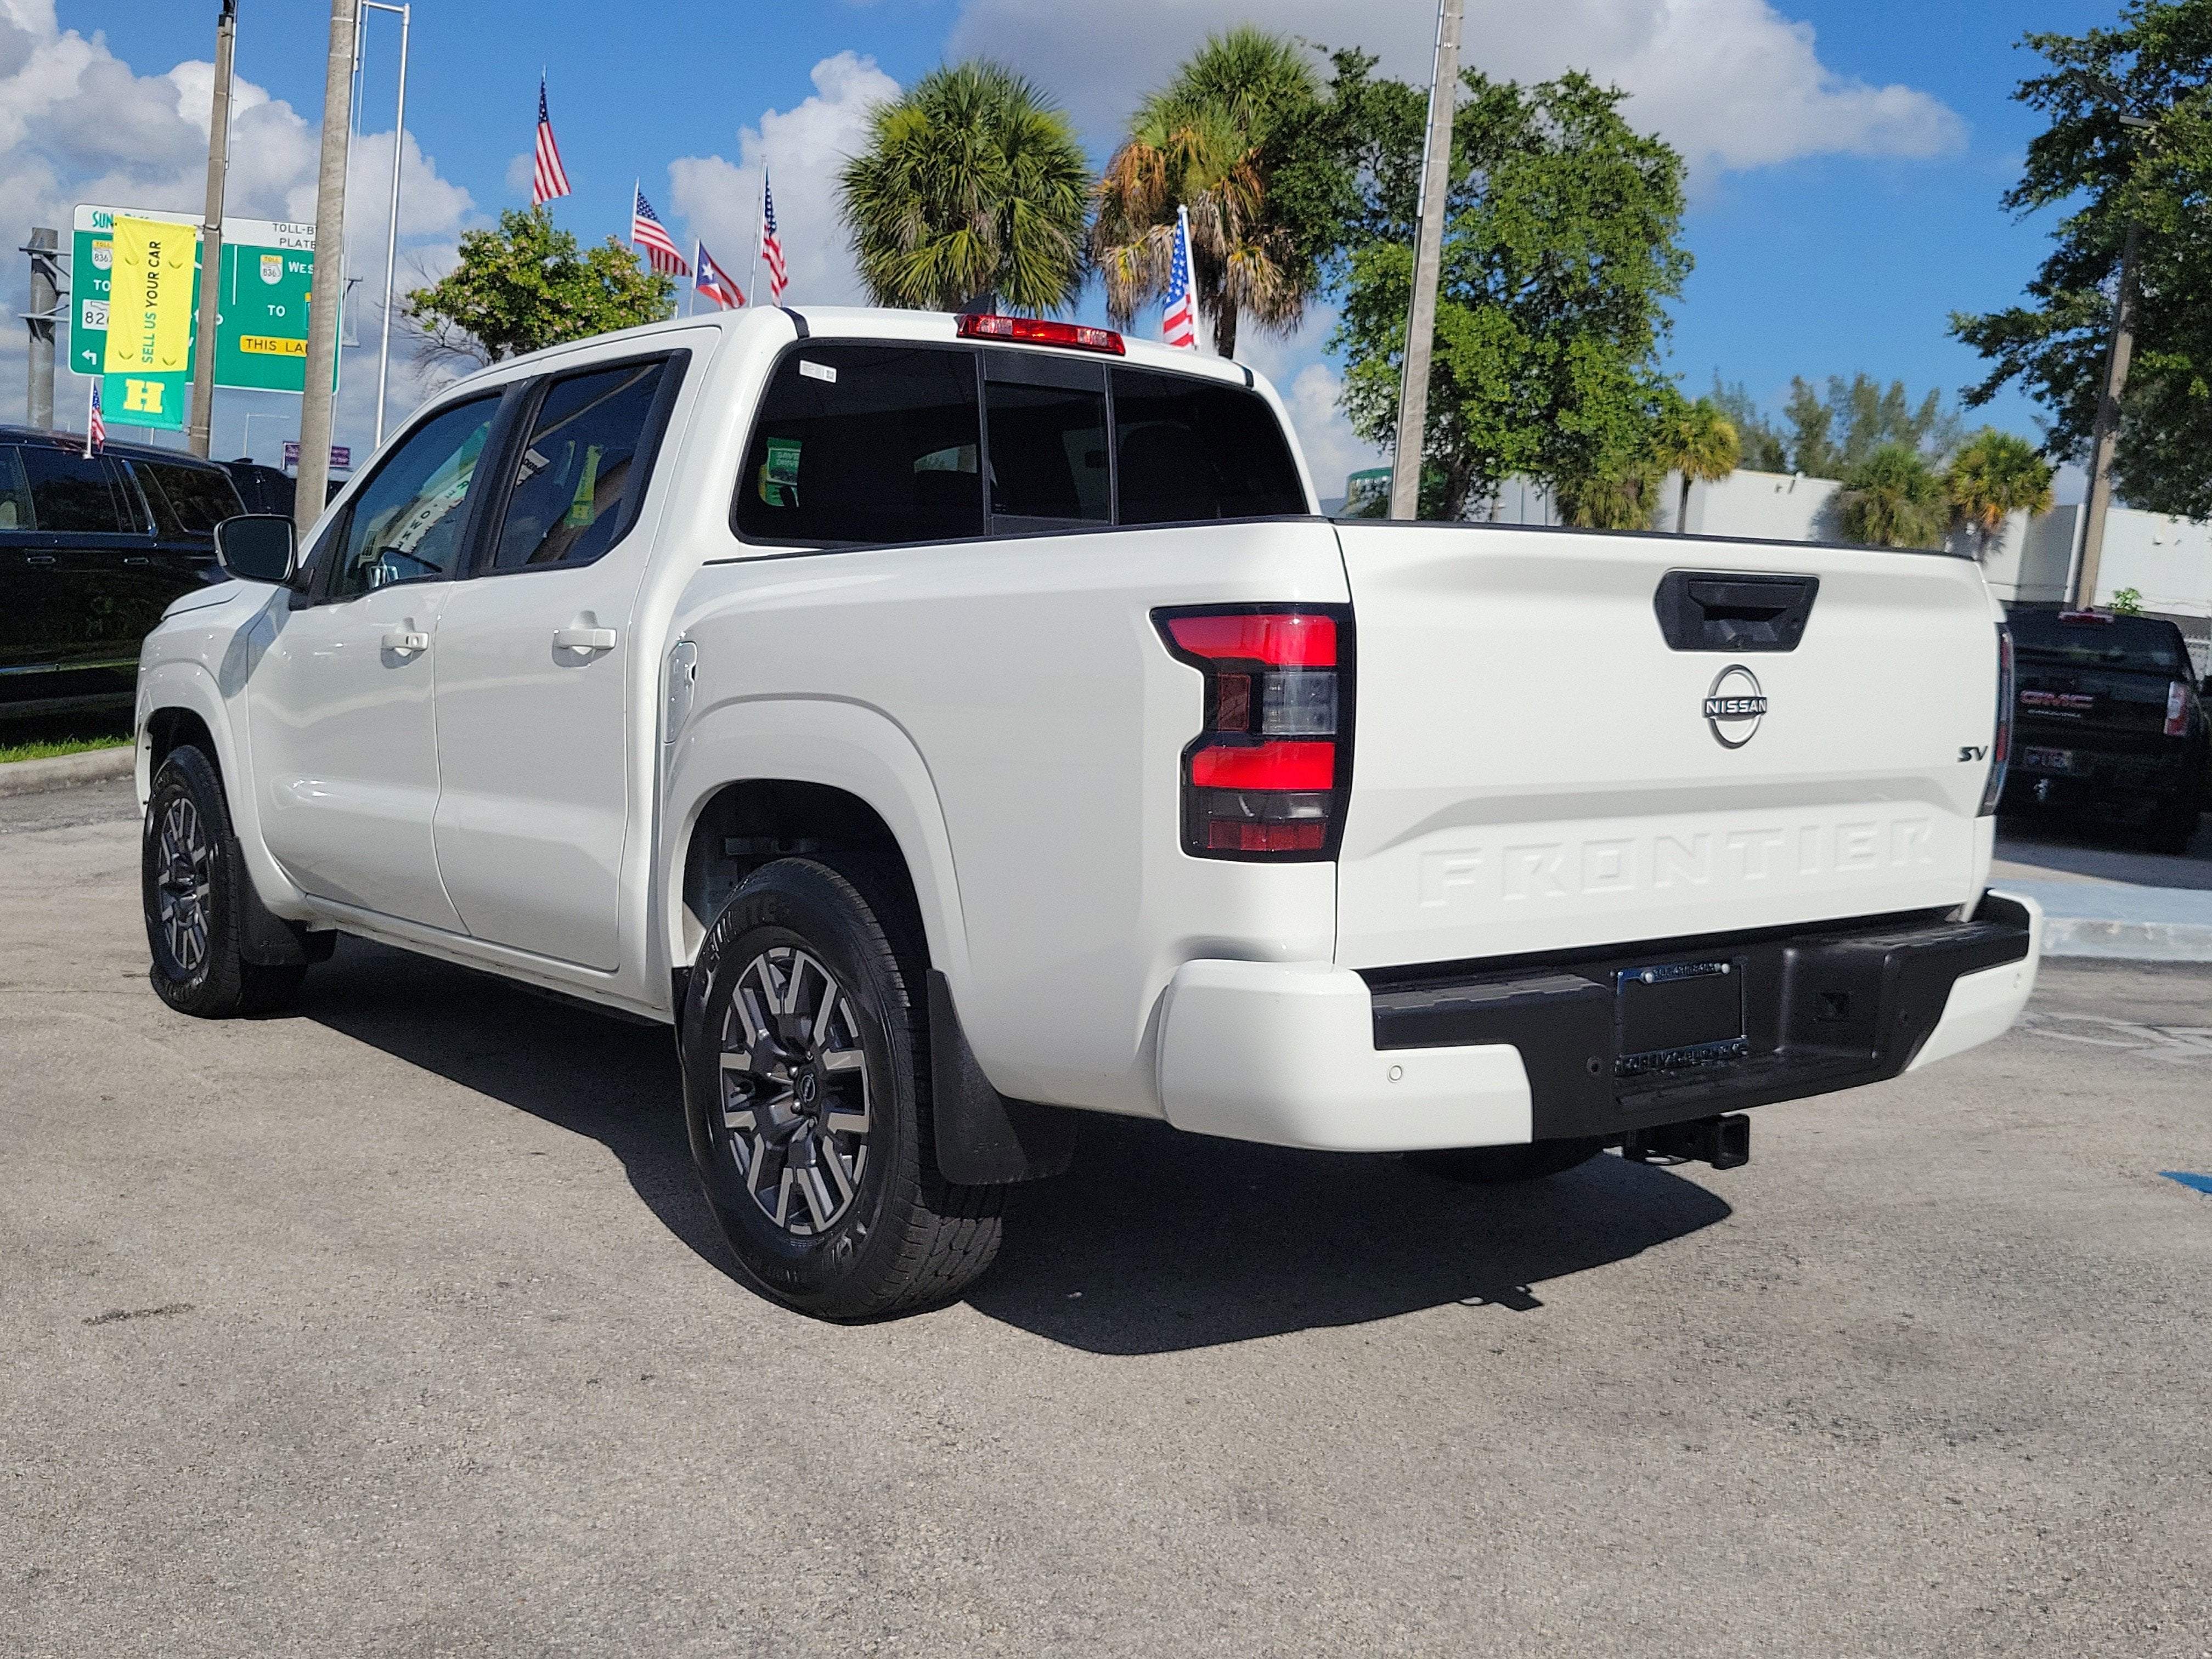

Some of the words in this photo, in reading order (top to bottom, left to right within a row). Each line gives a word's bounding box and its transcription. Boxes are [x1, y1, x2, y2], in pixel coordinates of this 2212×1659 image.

[272, 223, 315, 235] TOLL-B
[94, 253, 108, 262] 836
[149, 241, 162, 267] CAR
[263, 268, 276, 277] 836
[288, 261, 313, 274] WES
[93, 279, 111, 291] TO
[146, 272, 160, 308] YOUR
[267, 304, 285, 317] TO
[85, 312, 109, 325] 82
[144, 312, 157, 329] US
[142, 333, 155, 364] SELL
[246, 338, 277, 351] THIS
[285, 342, 307, 353] LA
[123, 379, 165, 414] H
[1706, 698, 1767, 714] NISSAN
[1957, 746, 1988, 763] SV
[1420, 817, 1933, 908] FRONTIER
